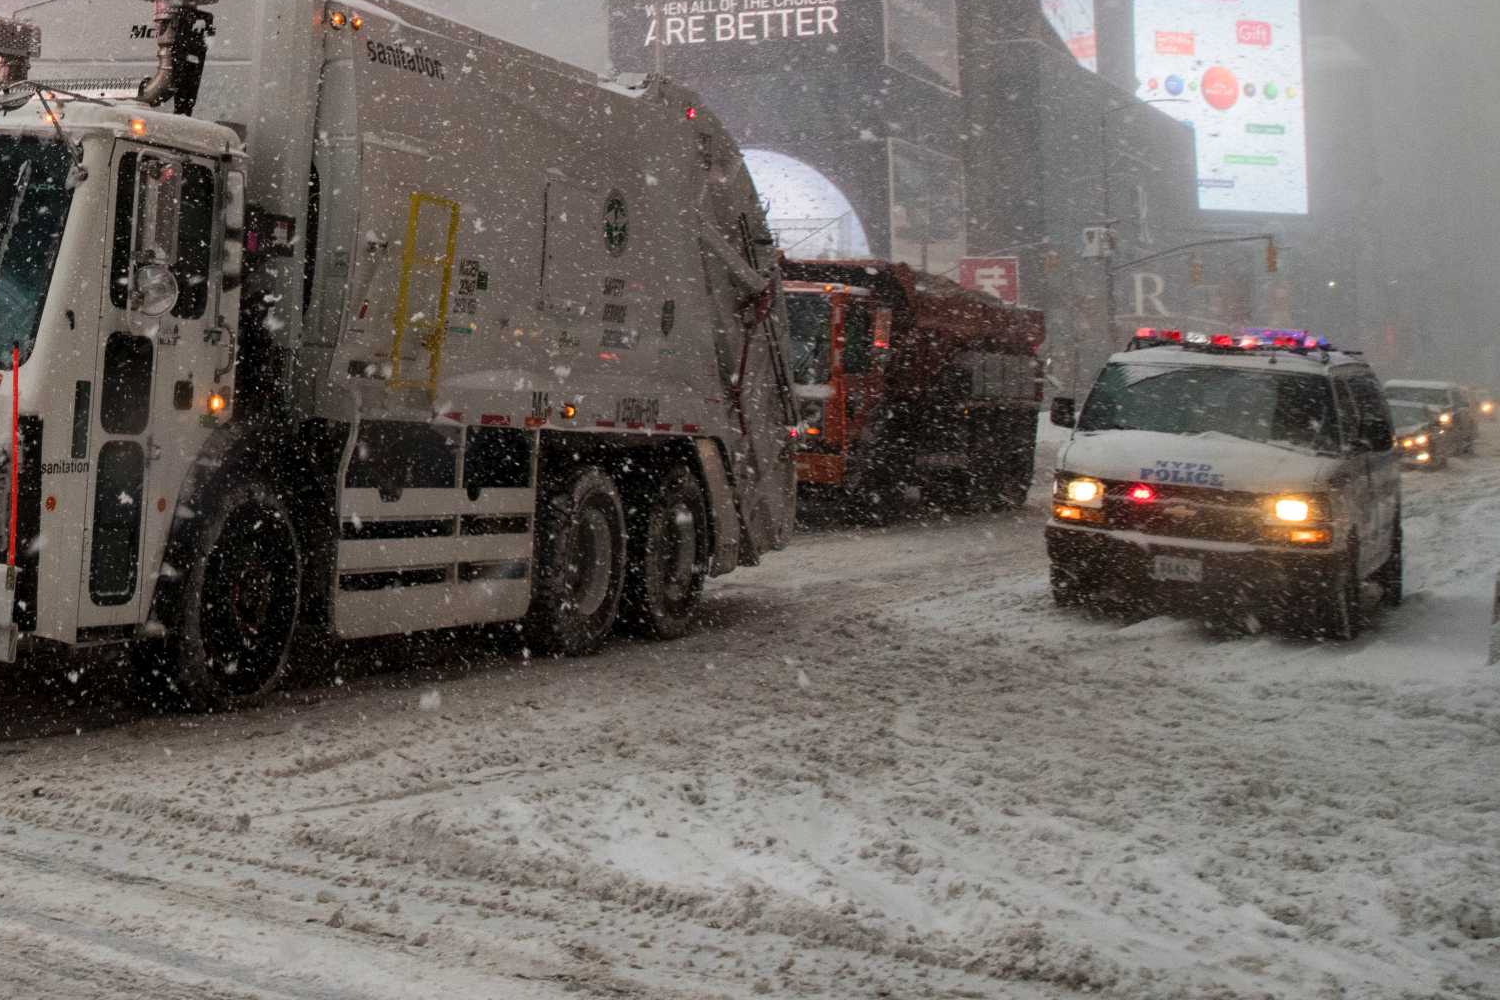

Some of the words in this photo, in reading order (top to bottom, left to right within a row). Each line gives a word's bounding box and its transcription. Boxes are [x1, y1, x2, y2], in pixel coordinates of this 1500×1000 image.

[690, 0, 718, 15] ALL
[644, 15, 706, 47] ARE
[715, 5, 839, 42] BETTER
[1238, 25, 1268, 43] Gift
[41, 459, 90, 474] sanitation
[1155, 459, 1212, 472] NYPD
[1138, 467, 1225, 487] POLICE
